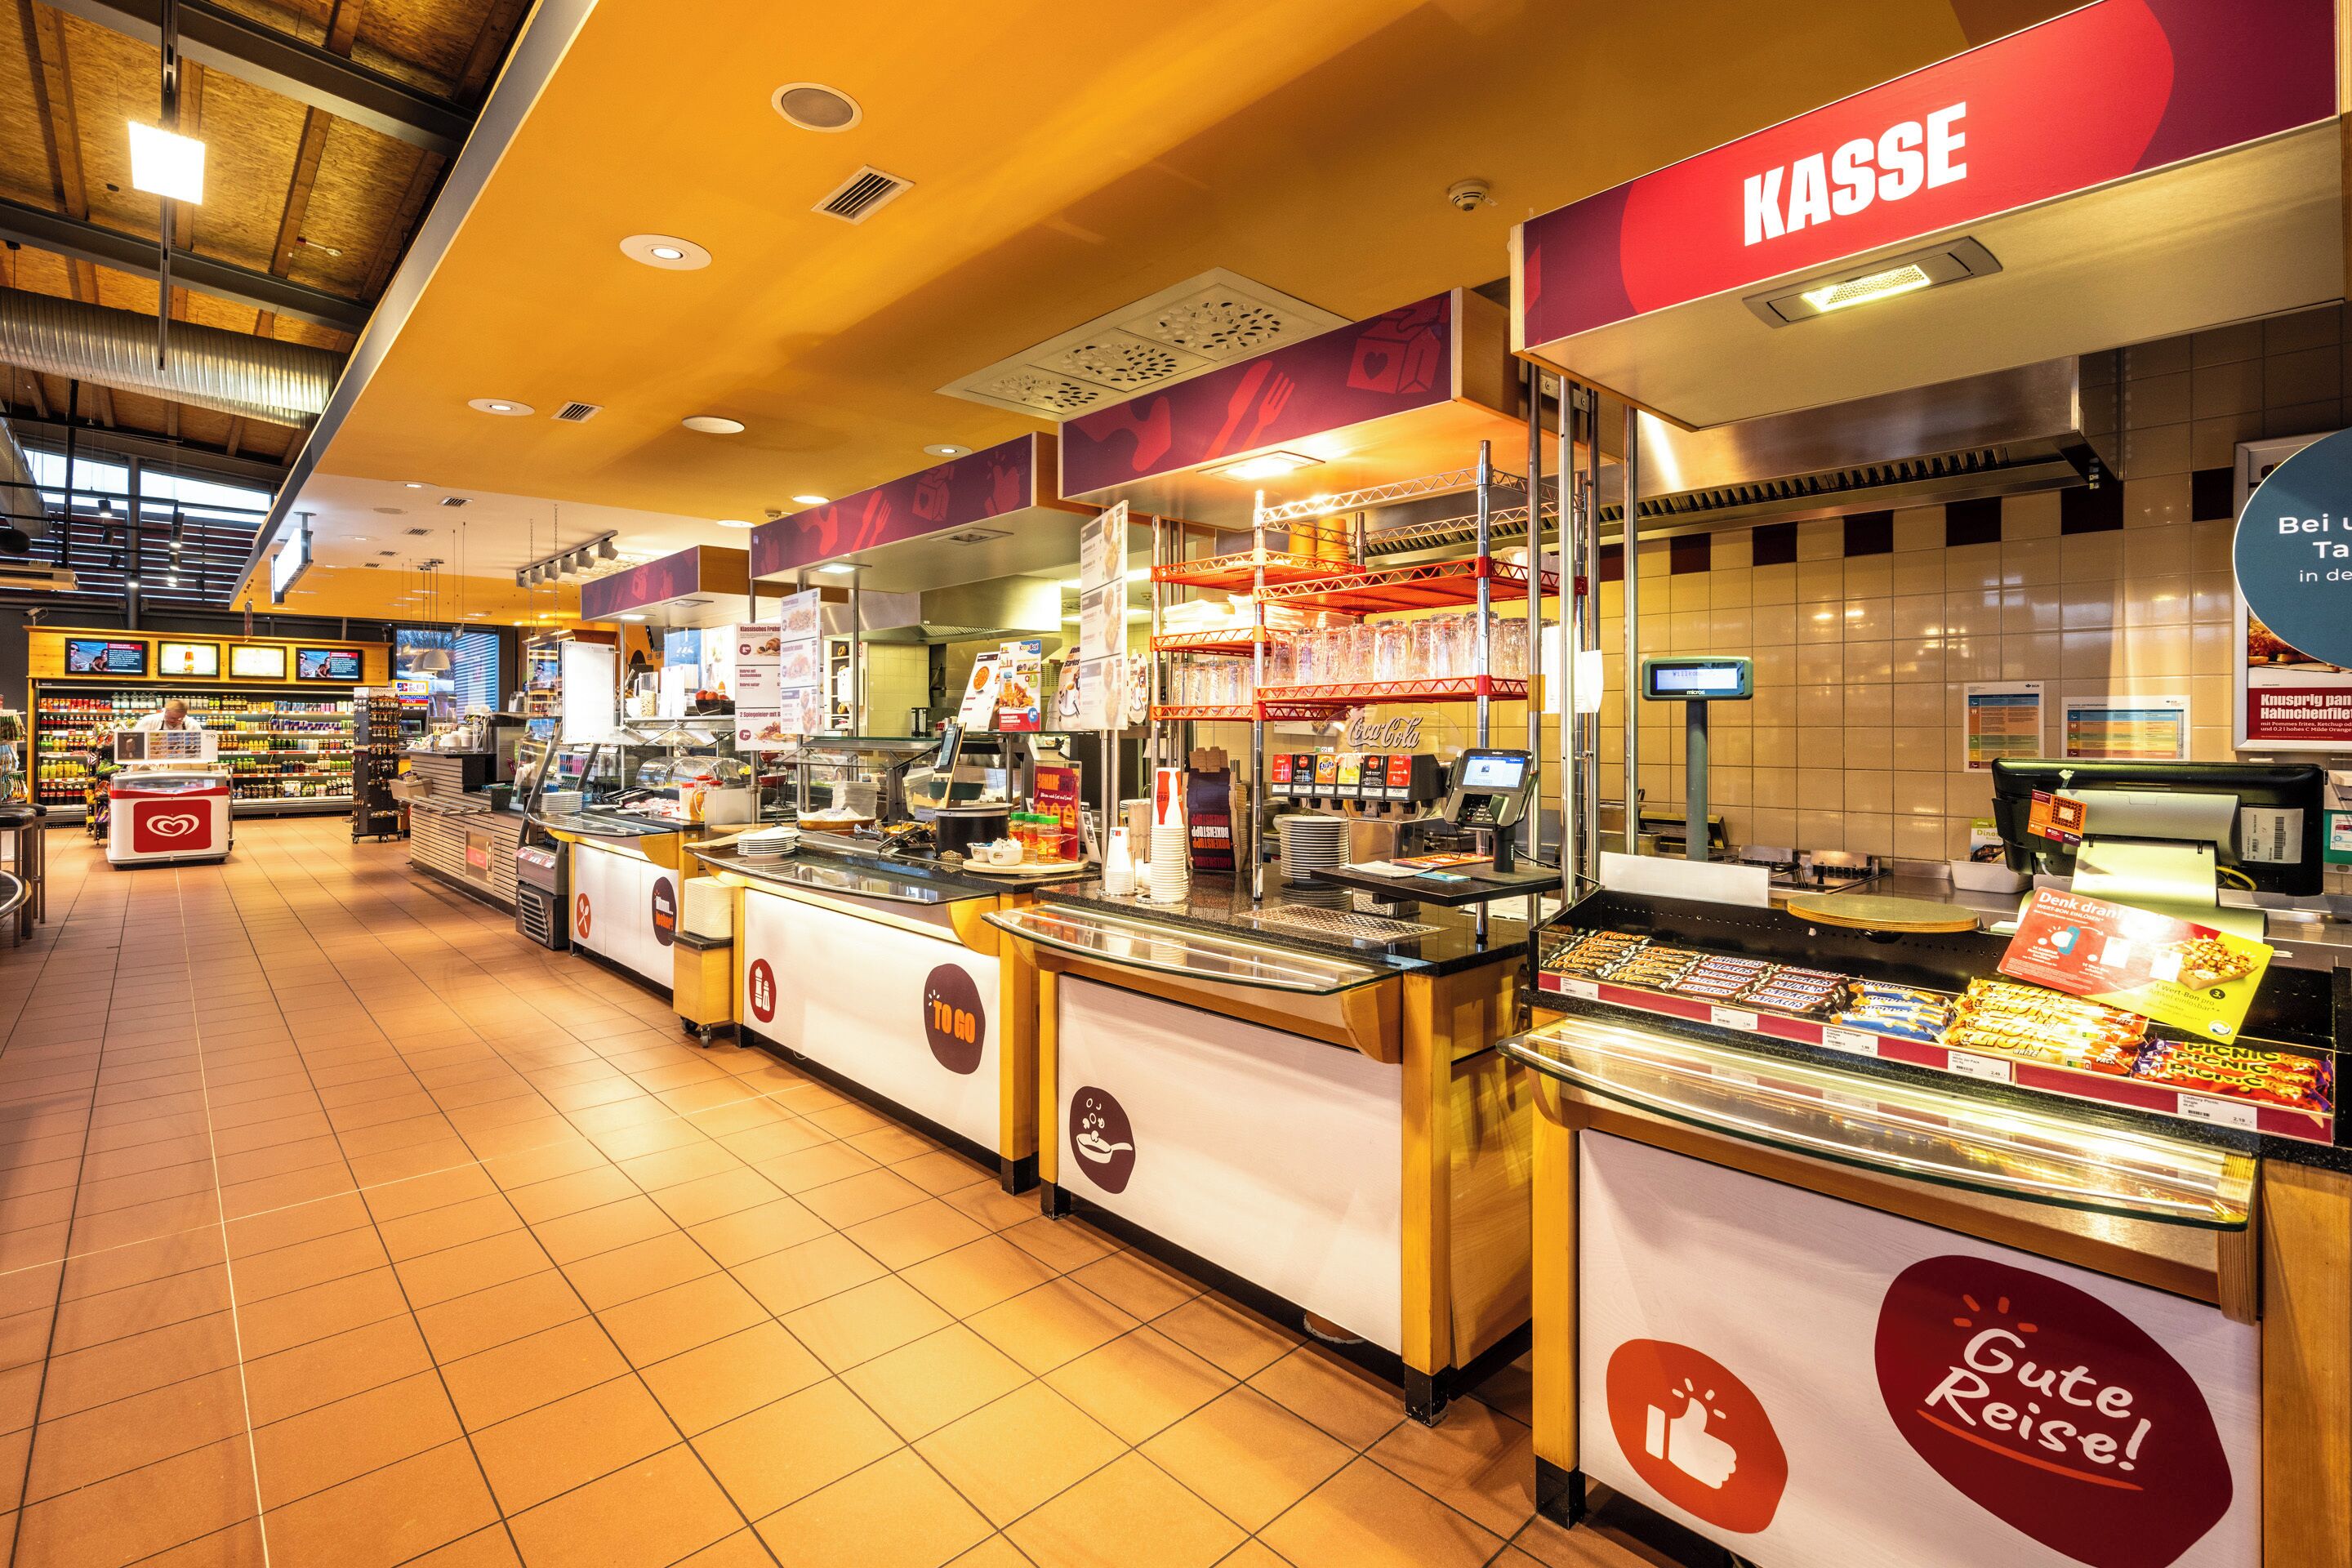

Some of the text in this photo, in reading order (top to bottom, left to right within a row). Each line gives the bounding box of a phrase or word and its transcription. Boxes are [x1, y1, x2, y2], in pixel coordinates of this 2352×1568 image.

[1744, 100, 1968, 247] KASSE
[2279, 513, 2329, 534] Bei
[2313, 541, 2350, 559] Ta
[2300, 568, 2352, 582] in de
[2261, 693, 2352, 706] Knusprig pan
[1348, 716, 1423, 748] Coca-Cola
[2054, 797, 2083, 809] FEEDBACK
[2051, 819, 2080, 831] FEEDBACK
[1192, 826, 1229, 838] BOXENSTOPP
[1192, 837, 1231, 849] BOXENSTOPP
[2039, 892, 2078, 910] Denk
[2036, 903, 2069, 915] WERT-BON
[1595, 931, 1646, 941] Mars
[1557, 954, 1609, 965] Mars
[1704, 961, 1754, 974] SNICKERS
[1608, 972, 1664, 984] Mars
[1699, 969, 1752, 982] SNICKERS
[1777, 973, 1833, 987] SNICKERS
[1681, 984, 1731, 995] SNICKERS
[1775, 980, 1829, 993] SNICKERS
[1764, 987, 1822, 1003] SNICKERS
[2162, 986, 2199, 1001] Wert-Bon
[2201, 997, 2215, 1006] pro
[2212, 990, 2222, 998] 3.
[1749, 995, 1805, 1009] SNICKERS
[933, 1000, 976, 1044] TO GO
[2115, 1018, 2134, 1027] PACK
[1971, 1033, 2044, 1052] LION
[2012, 1048, 2041, 1058] WHITE
[2185, 1042, 2281, 1063] PICNIC
[2096, 1056, 2116, 1066] PACK
[2172, 1050, 2272, 1075] PICNIC
[2183, 1094, 2203, 1102] Cadbury
[1963, 1328, 2134, 1420] Gute
[1924, 1365, 2153, 1472] Reise!
